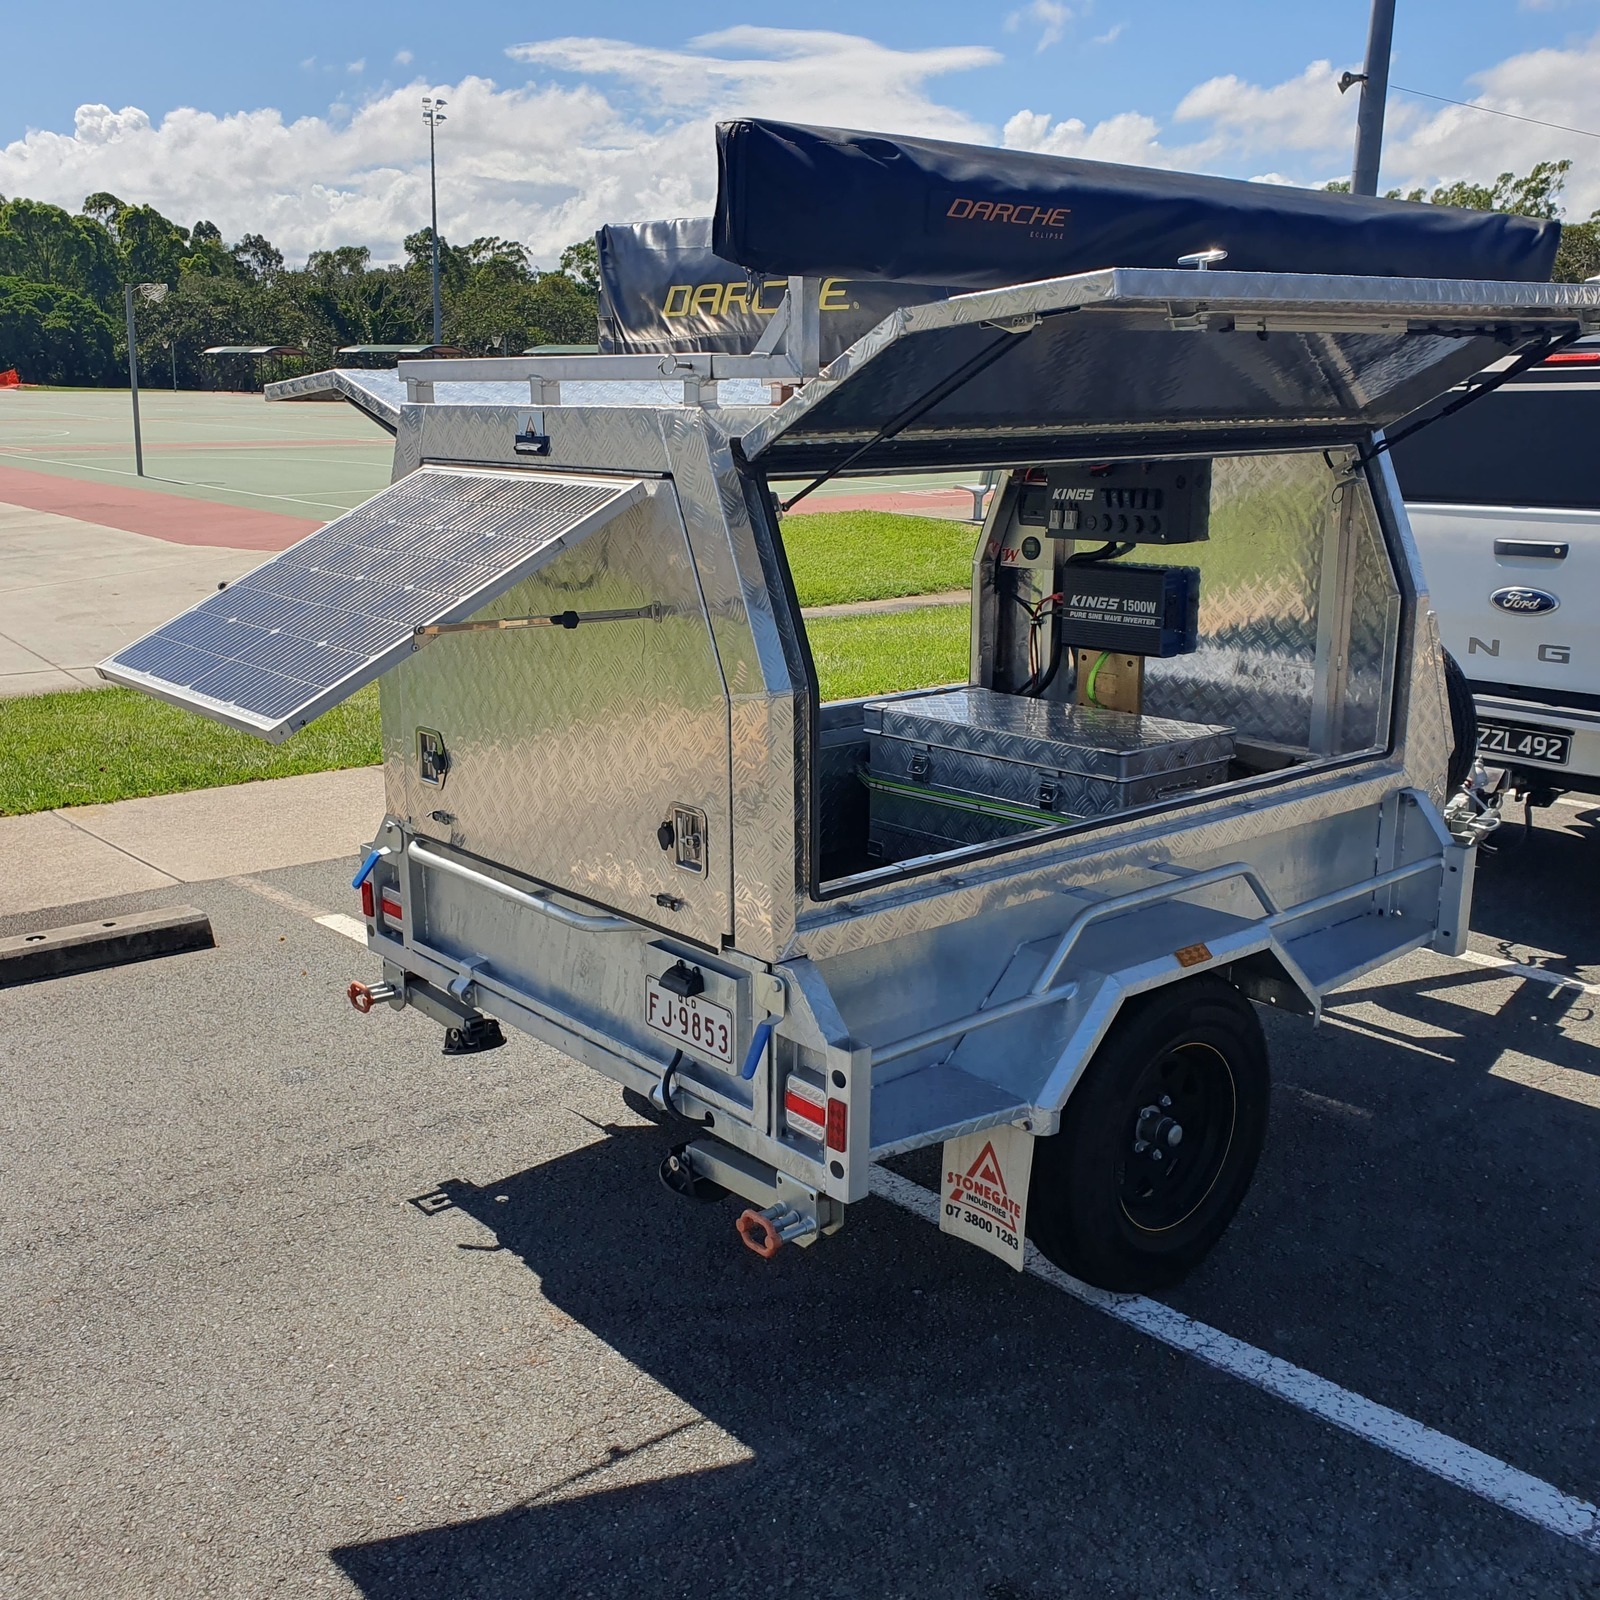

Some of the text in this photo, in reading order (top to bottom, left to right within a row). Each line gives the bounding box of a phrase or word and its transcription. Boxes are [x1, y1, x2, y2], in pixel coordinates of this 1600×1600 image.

[946, 198, 1071, 227] DARCHE
[1030, 231, 1064, 240] ECLIPSE
[662, 277, 850, 317] DARCE
[1052, 488, 1095, 501] KINGS
[1069, 595, 1157, 614] KINGS 1500W
[1503, 591, 1541, 610] Ford
[1069, 611, 1156, 626] PURE SINE WAVE INVERTER
[1477, 727, 1562, 760] ZZL492
[946, 1171, 1021, 1219] STONEGATE
[965, 1193, 1007, 1219] INDUSTRIES
[945, 1203, 1019, 1251] 07 3800 1283
